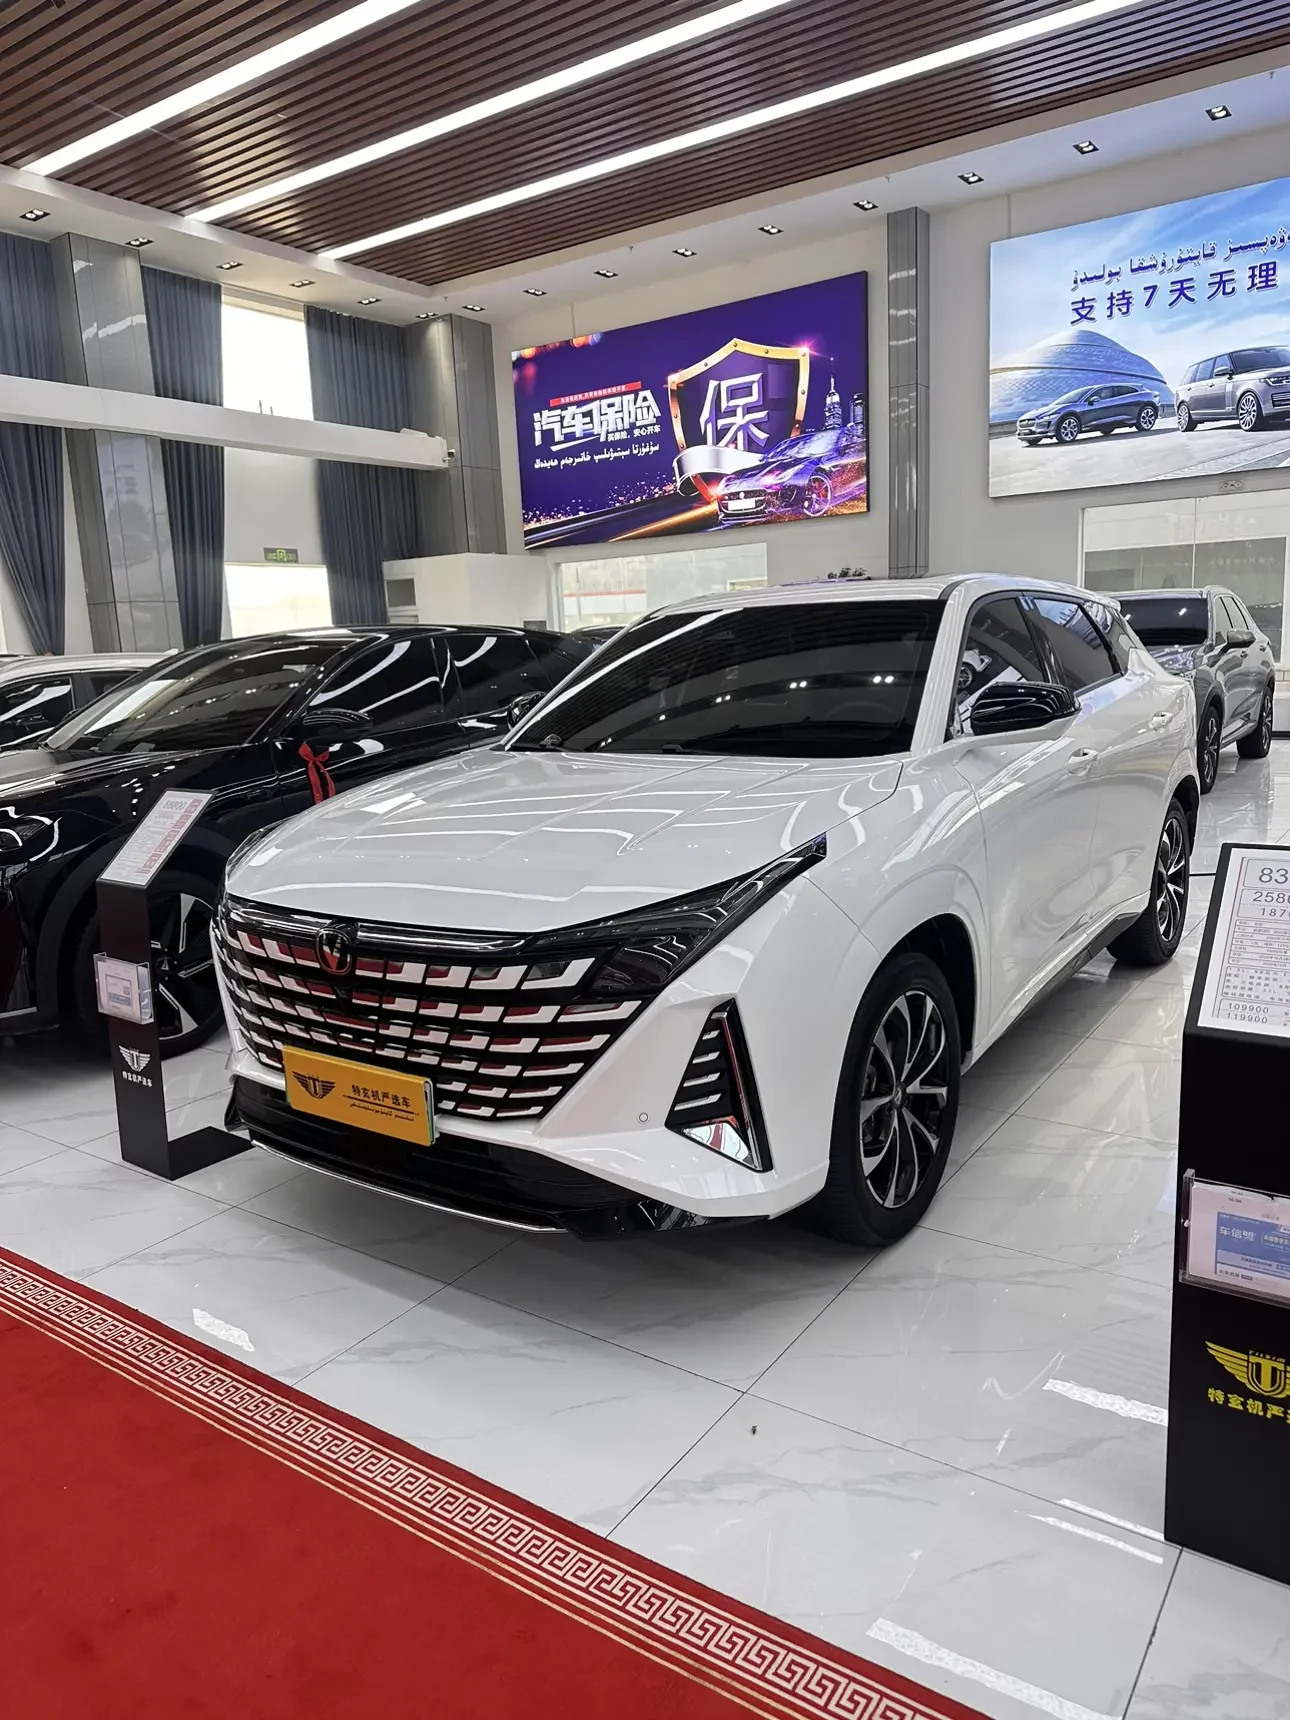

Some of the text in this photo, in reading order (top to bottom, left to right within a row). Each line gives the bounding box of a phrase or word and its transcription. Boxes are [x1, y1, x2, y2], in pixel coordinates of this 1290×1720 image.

[1222, 226, 1290, 262] ۋەپسىز
[1070, 260, 1279, 326] 支持7天无理
[533, 389, 661, 446] 汽车保险
[700, 372, 770, 451] 保
[1252, 890, 1290, 904] 258
[1261, 907, 1290, 918] 187
[351, 1084, 411, 1108] 特玄机严选车
[1207, 1387, 1290, 1424] 特玄机严
